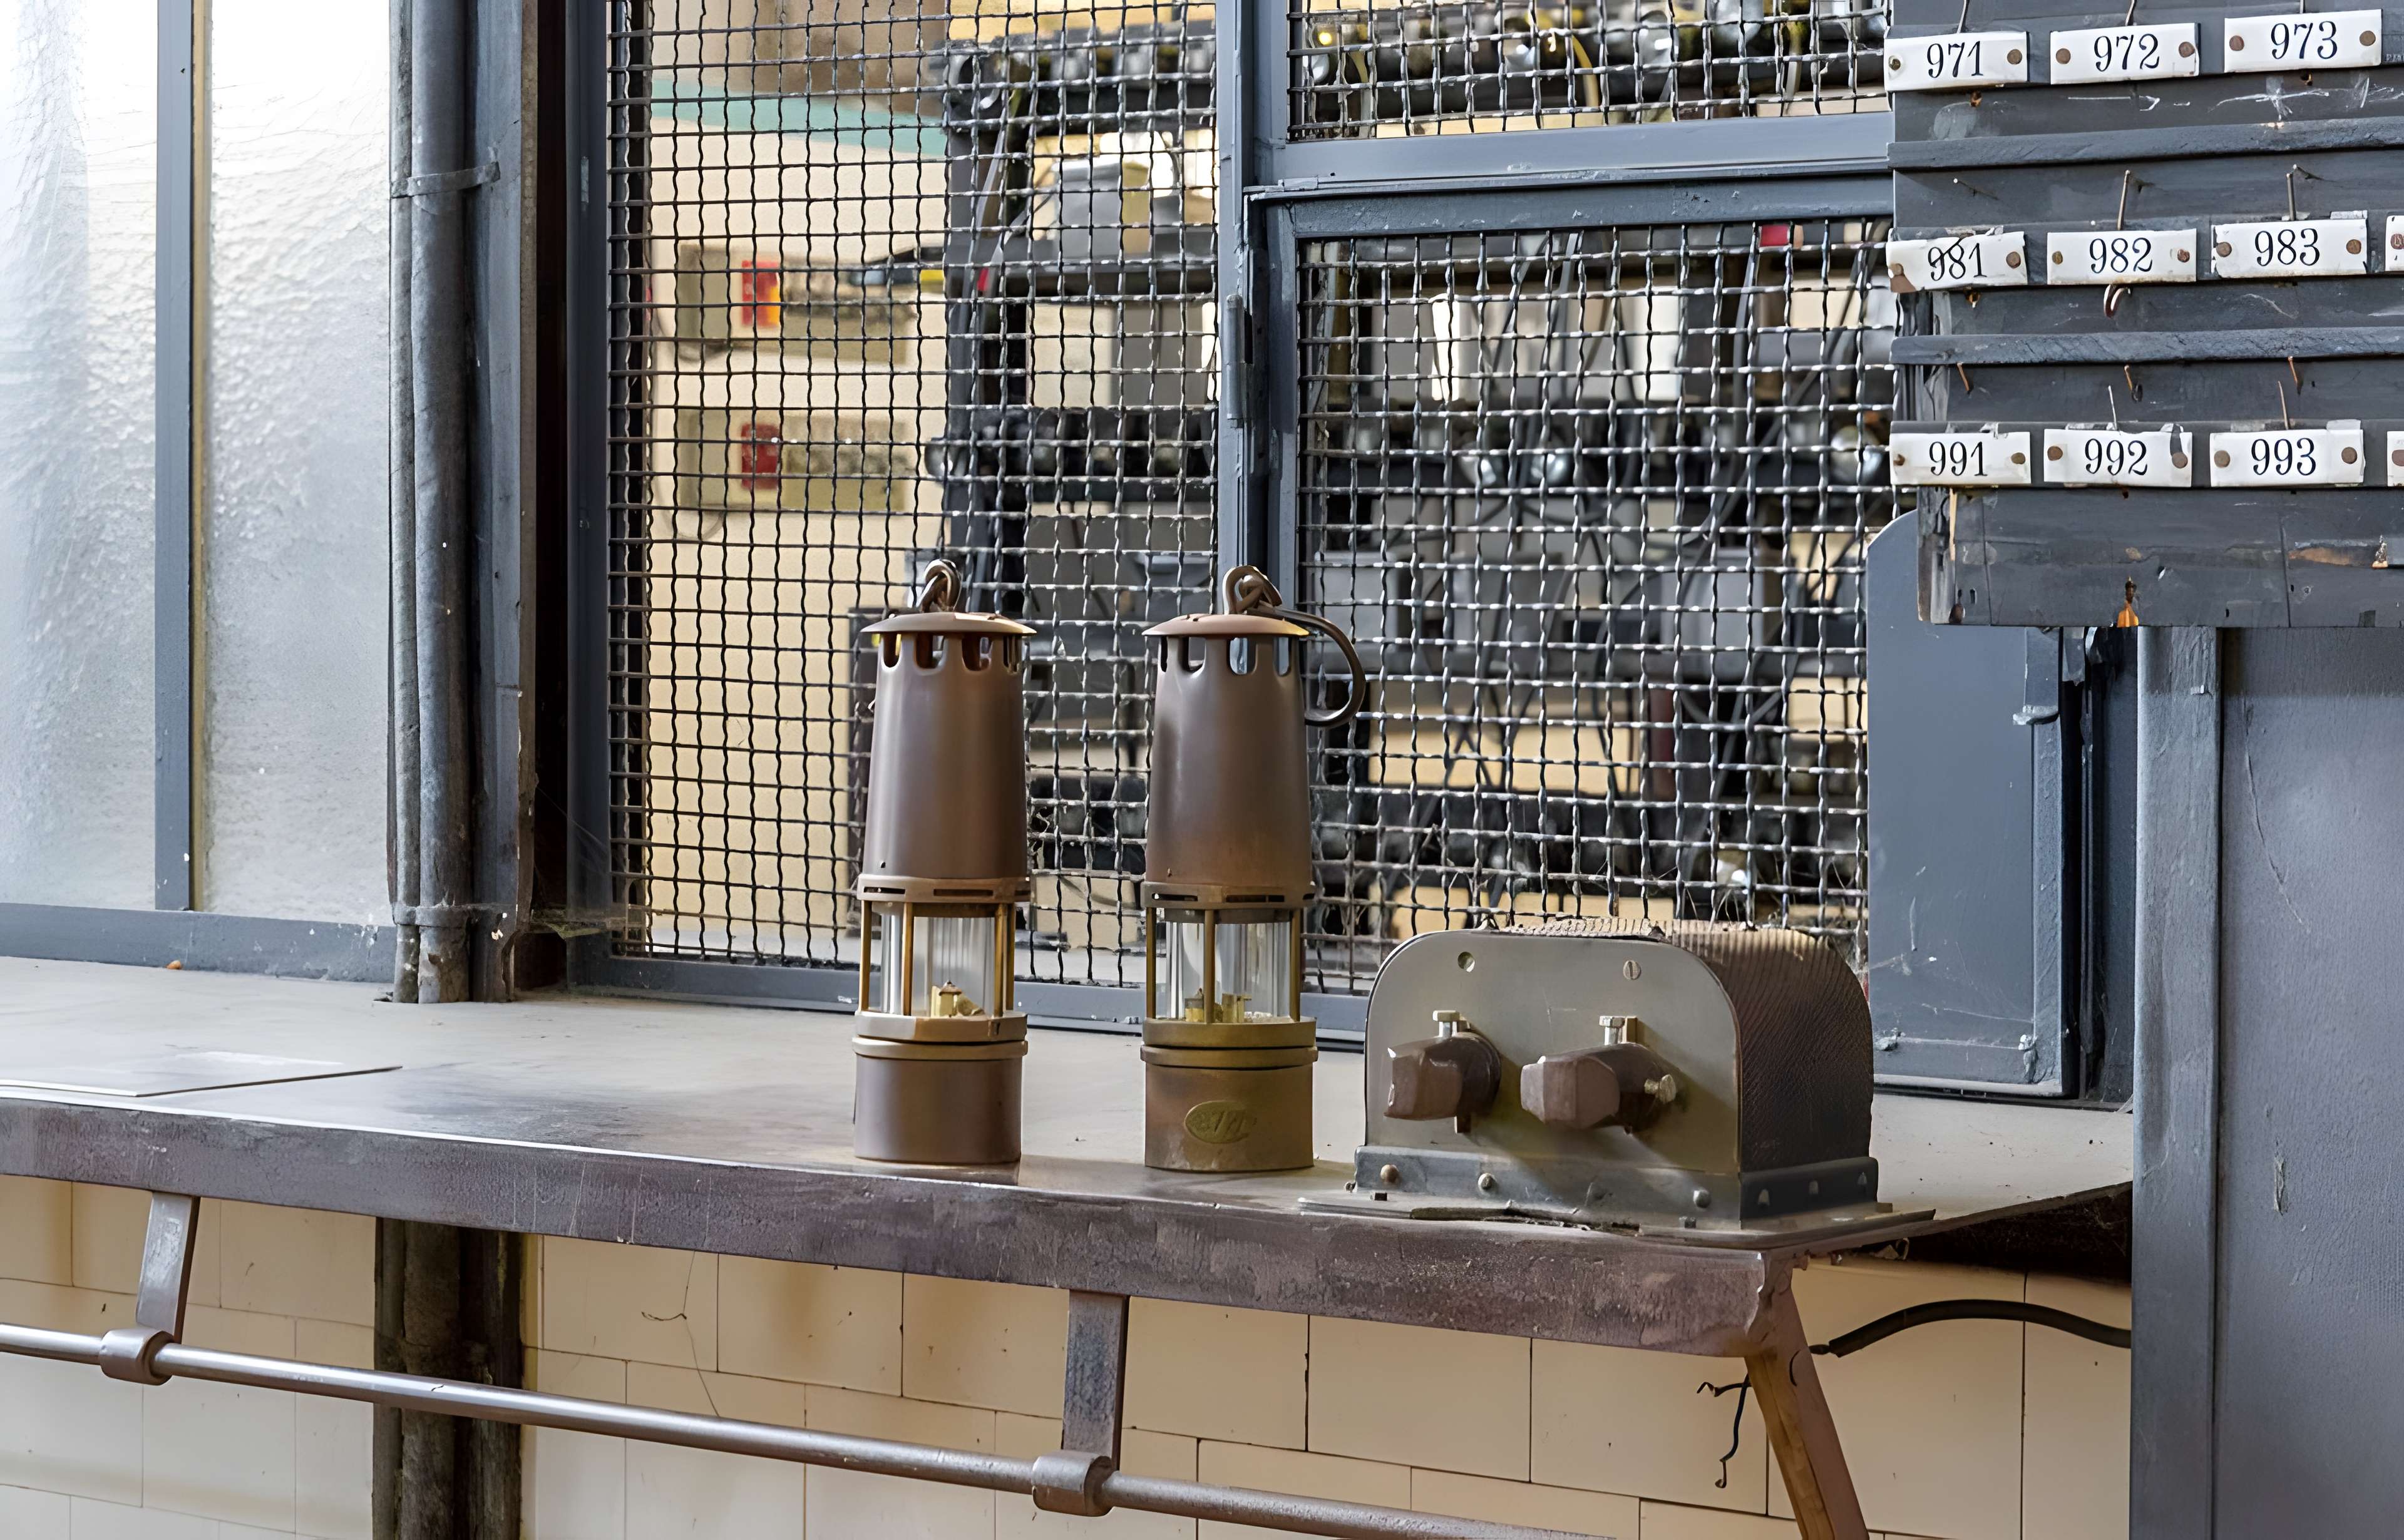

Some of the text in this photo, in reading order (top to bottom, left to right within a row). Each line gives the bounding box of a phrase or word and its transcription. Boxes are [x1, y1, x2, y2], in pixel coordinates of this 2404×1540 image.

[2093, 33, 2160, 72] 972
[2271, 21, 2338, 59] 973
[1927, 41, 1983, 78] 971
[1928, 242, 1988, 281] 981
[2089, 237, 2153, 274] 982
[2254, 228, 2320, 267] 983
[1929, 441, 1988, 476] 991
[2085, 438, 2148, 476] 992
[2251, 438, 2316, 476] 993
